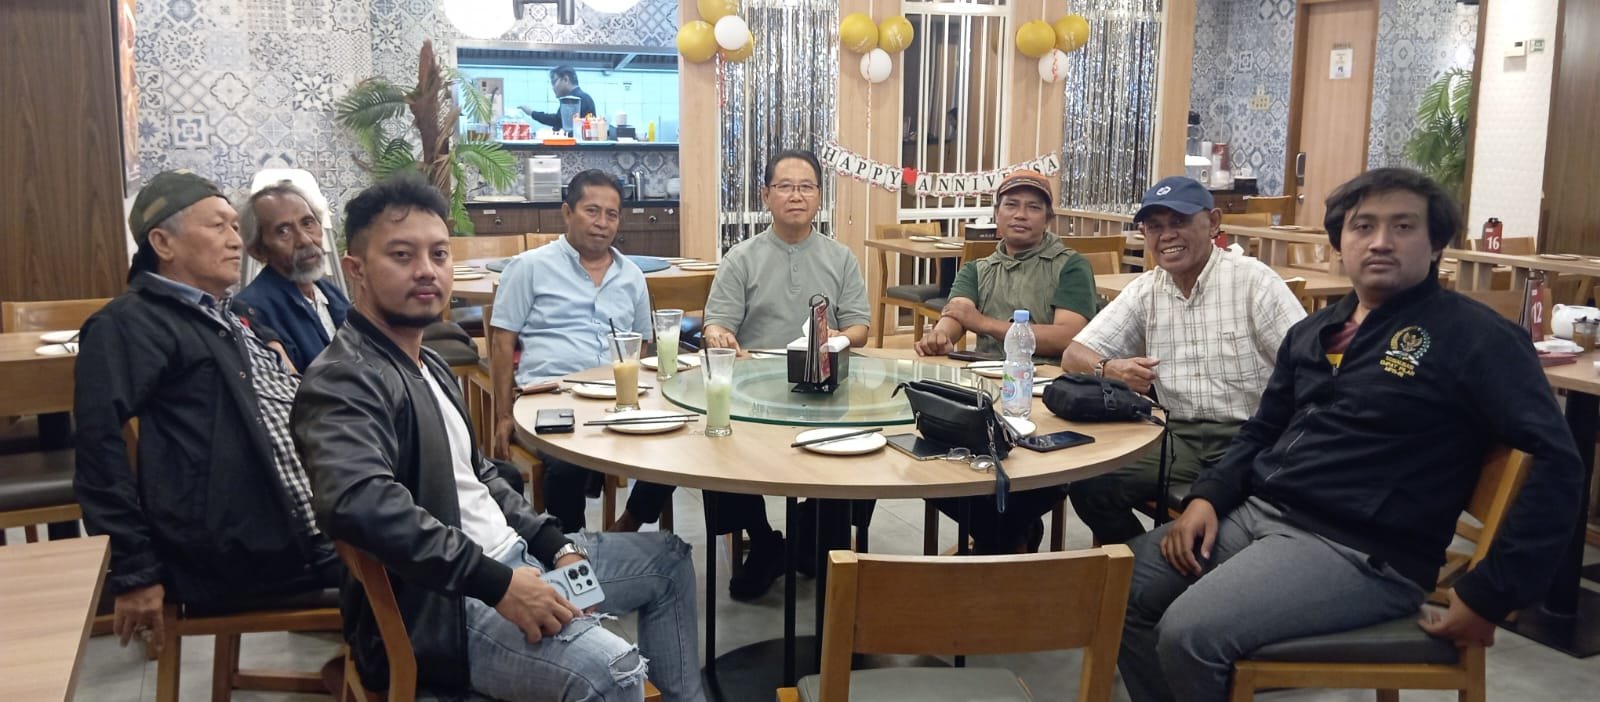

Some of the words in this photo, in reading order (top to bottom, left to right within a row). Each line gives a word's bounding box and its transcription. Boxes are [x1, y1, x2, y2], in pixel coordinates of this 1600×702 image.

[823, 147, 900, 185] HAPPY
[918, 158, 1057, 191] ANNIVSA
[1487, 236, 1500, 250] 16
[1532, 302, 1543, 324] 12
